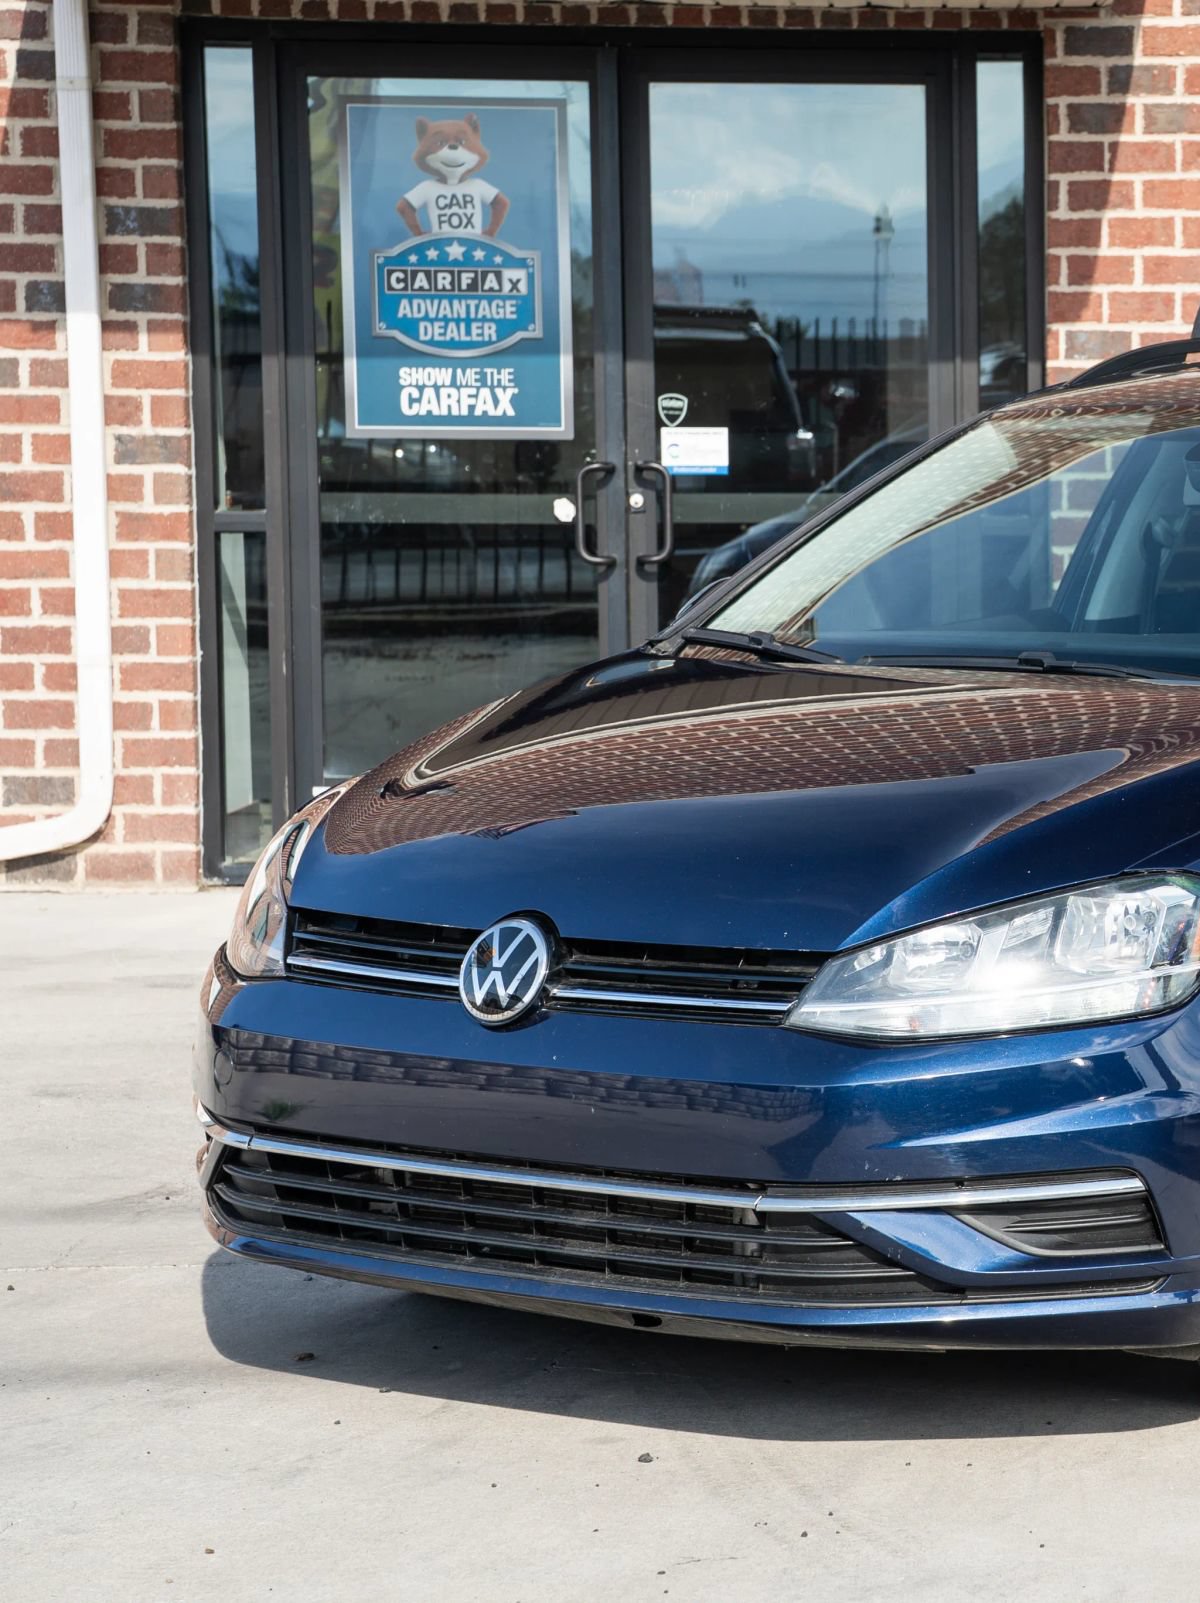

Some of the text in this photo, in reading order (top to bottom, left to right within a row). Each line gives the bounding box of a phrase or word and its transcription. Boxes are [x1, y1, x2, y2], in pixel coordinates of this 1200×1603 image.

[435, 193, 475, 211] CAR
[437, 212, 475, 230] FOX
[390, 271, 522, 293] CARFAX
[397, 298, 517, 319] ADVANTAGE
[419, 321, 497, 341] DEALER
[399, 367, 515, 387] SHOW ME THE
[400, 386, 516, 417] CARFAX
